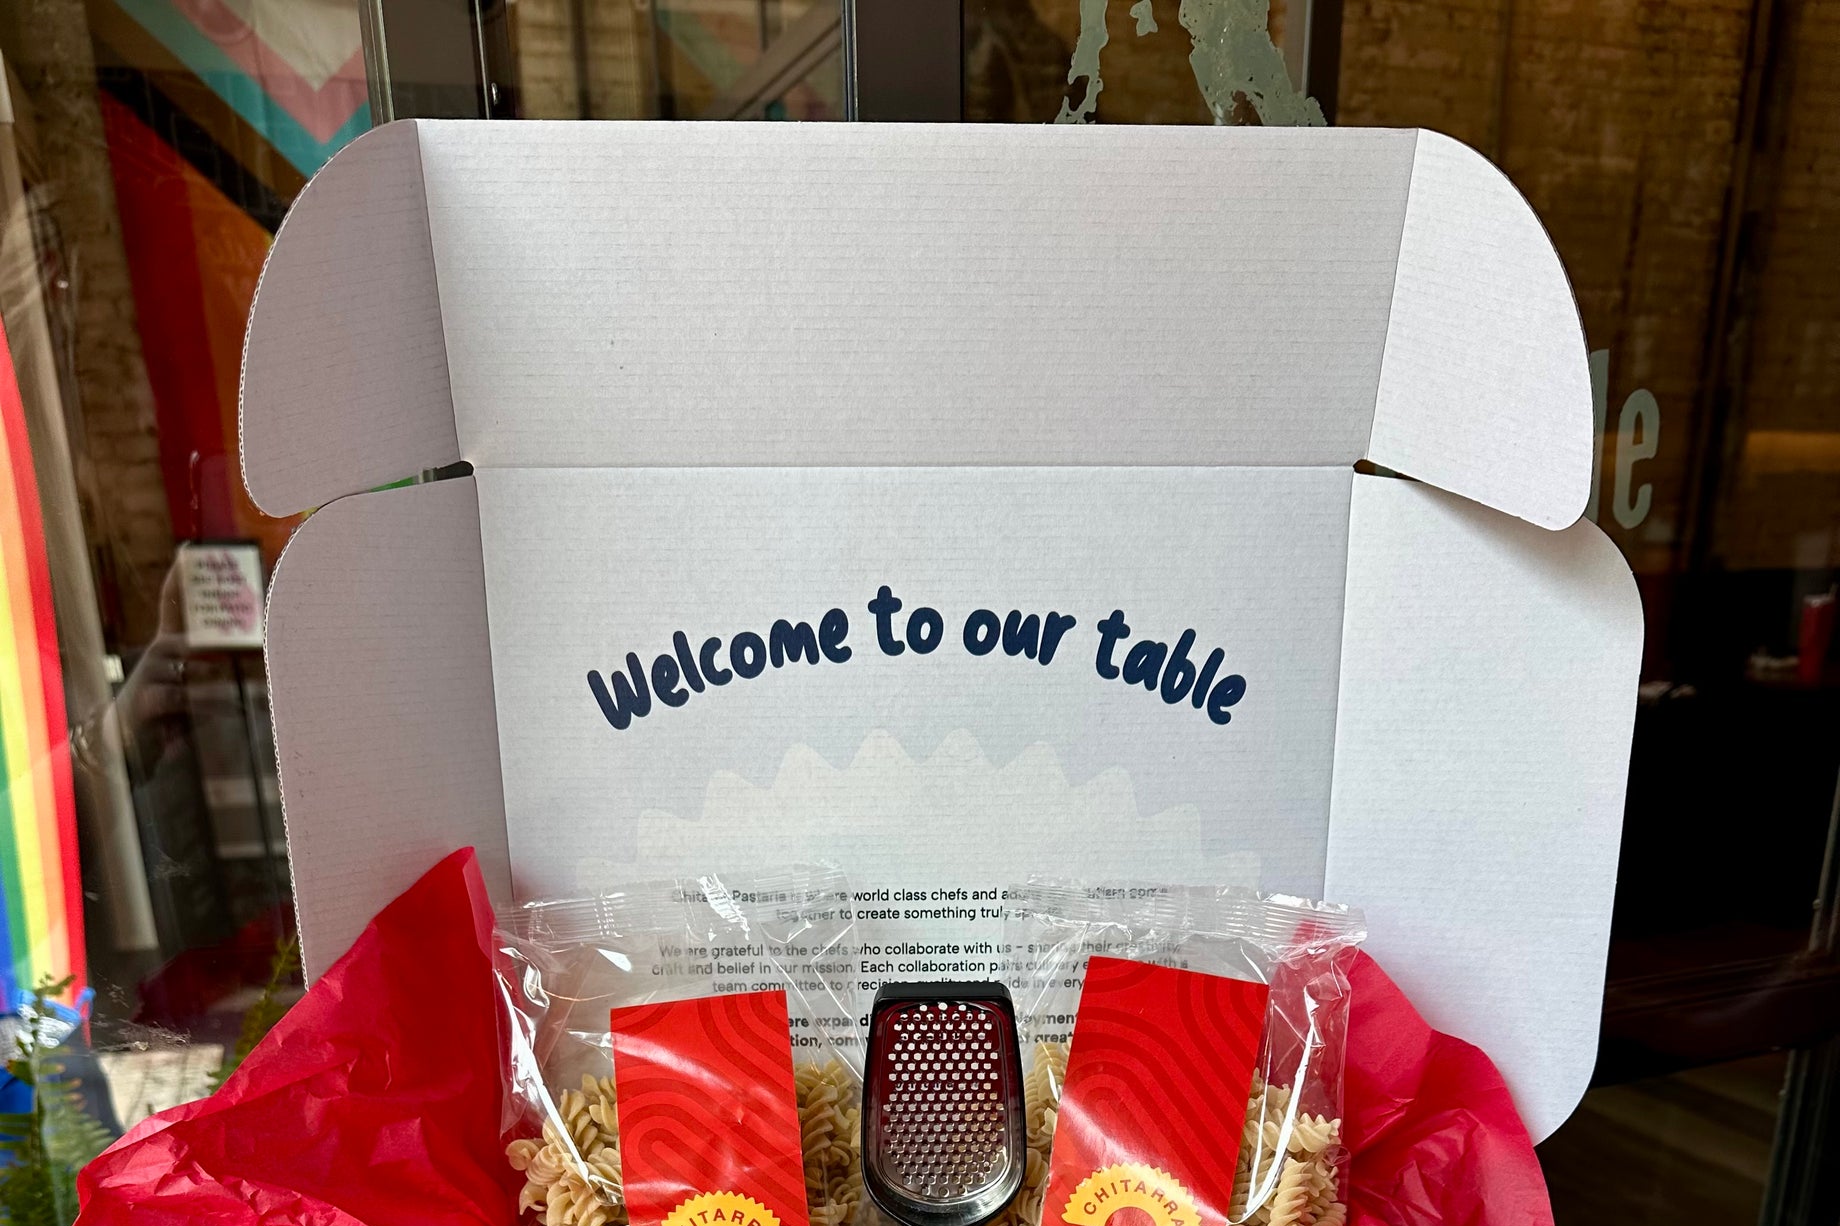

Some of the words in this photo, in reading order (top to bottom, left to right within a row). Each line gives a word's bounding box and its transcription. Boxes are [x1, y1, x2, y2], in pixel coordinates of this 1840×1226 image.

[587, 607, 853, 730] Welcome
[867, 585, 944, 656] to
[962, 608, 1077, 666] our
[1096, 609, 1247, 726] table
[852, 889, 890, 901] world
[893, 889, 927, 901] class
[931, 888, 968, 900] chefs
[971, 887, 998, 900] and
[839, 908, 853, 920] to
[857, 907, 900, 920] create
[904, 906, 976, 921] something
[660, 945, 682, 957] We
[688, 946, 708, 957] are
[711, 943, 764, 960] grateful
[768, 944, 783, 956] to
[785, 944, 808, 956] the
[811, 943, 849, 956] chefs
[885, 942, 960, 955] collaborate
[963, 941, 993, 954] with
[996, 944, 1012, 954] us
[1082, 940, 1113, 953] their
[717, 962, 756, 974] belief
[759, 963, 772, 974] in
[860, 960, 894, 973] Each
[898, 959, 985, 973] collaboration
[712, 981, 747, 992] team
[829, 979, 843, 991] to
